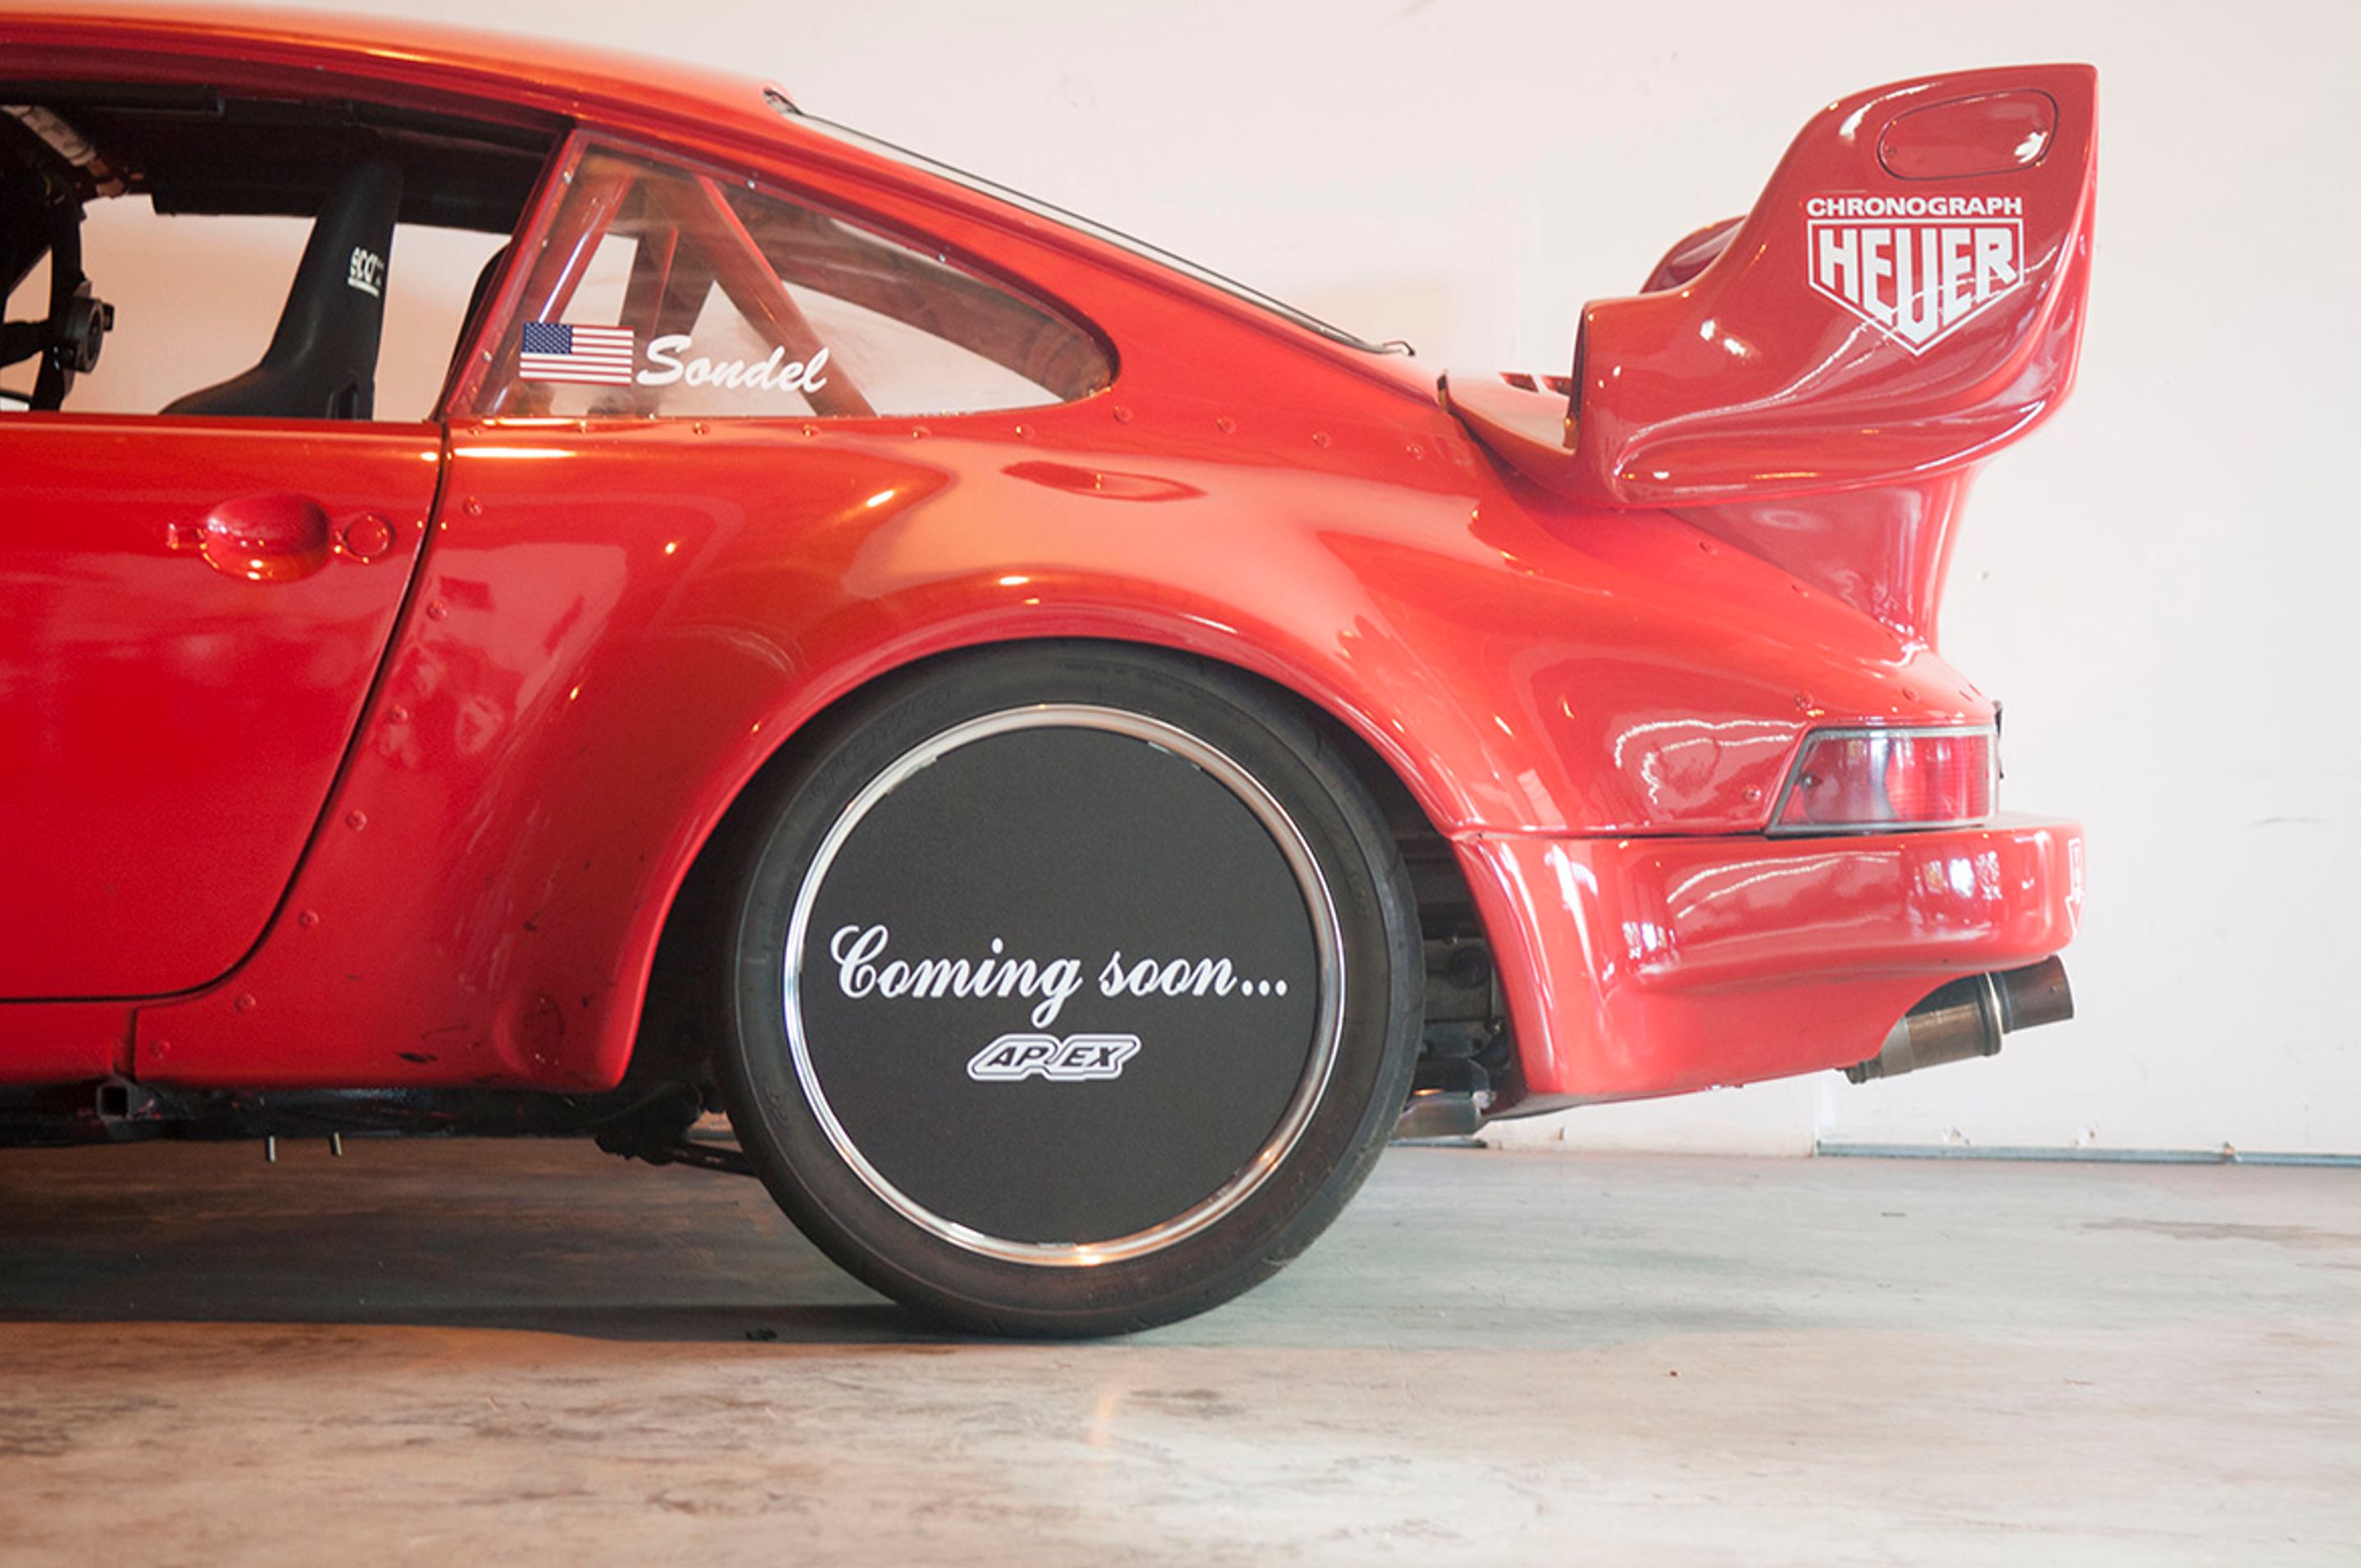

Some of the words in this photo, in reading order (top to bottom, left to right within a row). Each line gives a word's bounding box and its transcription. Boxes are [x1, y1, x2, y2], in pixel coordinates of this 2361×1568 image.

[1807, 197, 2022, 216] CHRONOGRAPH
[1819, 227, 2018, 344] HEUER
[636, 334, 830, 393] Sondel
[830, 925, 1083, 1029] Coming
[1099, 951, 1288, 997] soon...
